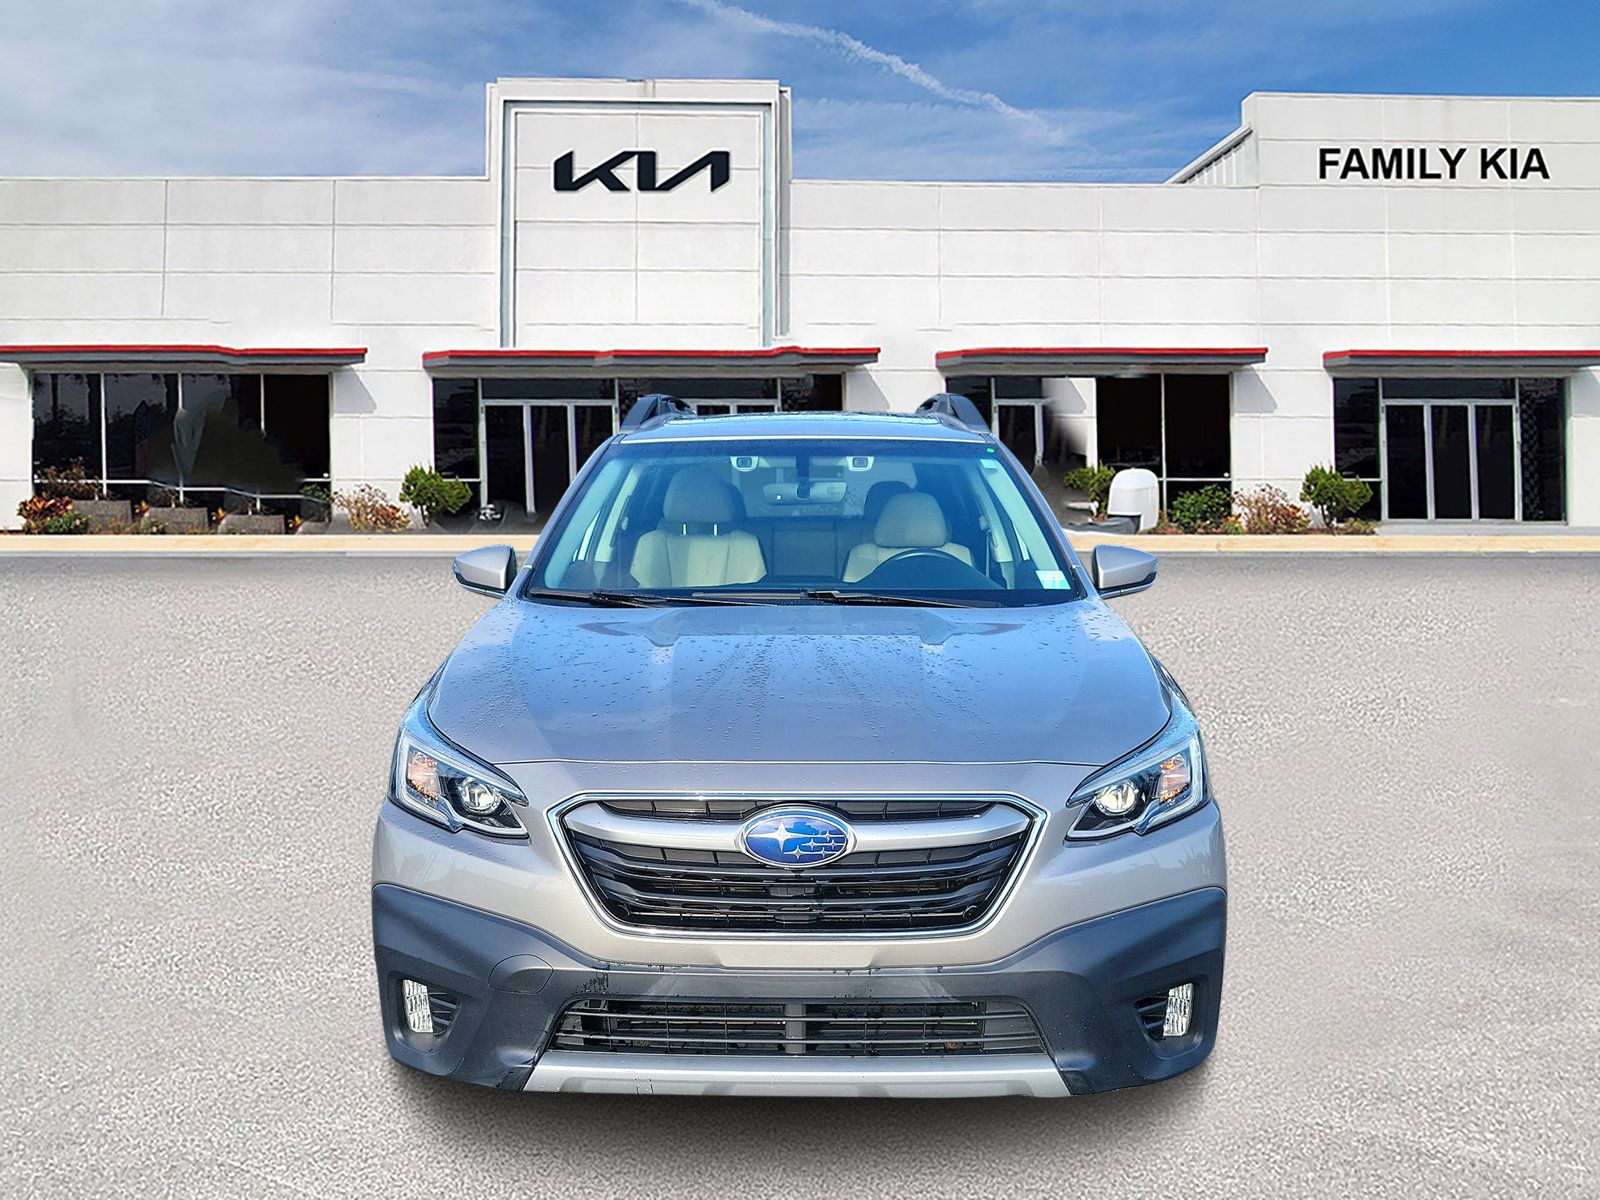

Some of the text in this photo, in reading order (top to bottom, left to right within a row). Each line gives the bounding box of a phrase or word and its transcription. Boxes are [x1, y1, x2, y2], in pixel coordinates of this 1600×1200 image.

[553, 151, 730, 193] KIA
[1320, 148, 1550, 180] FAMILY KIA
